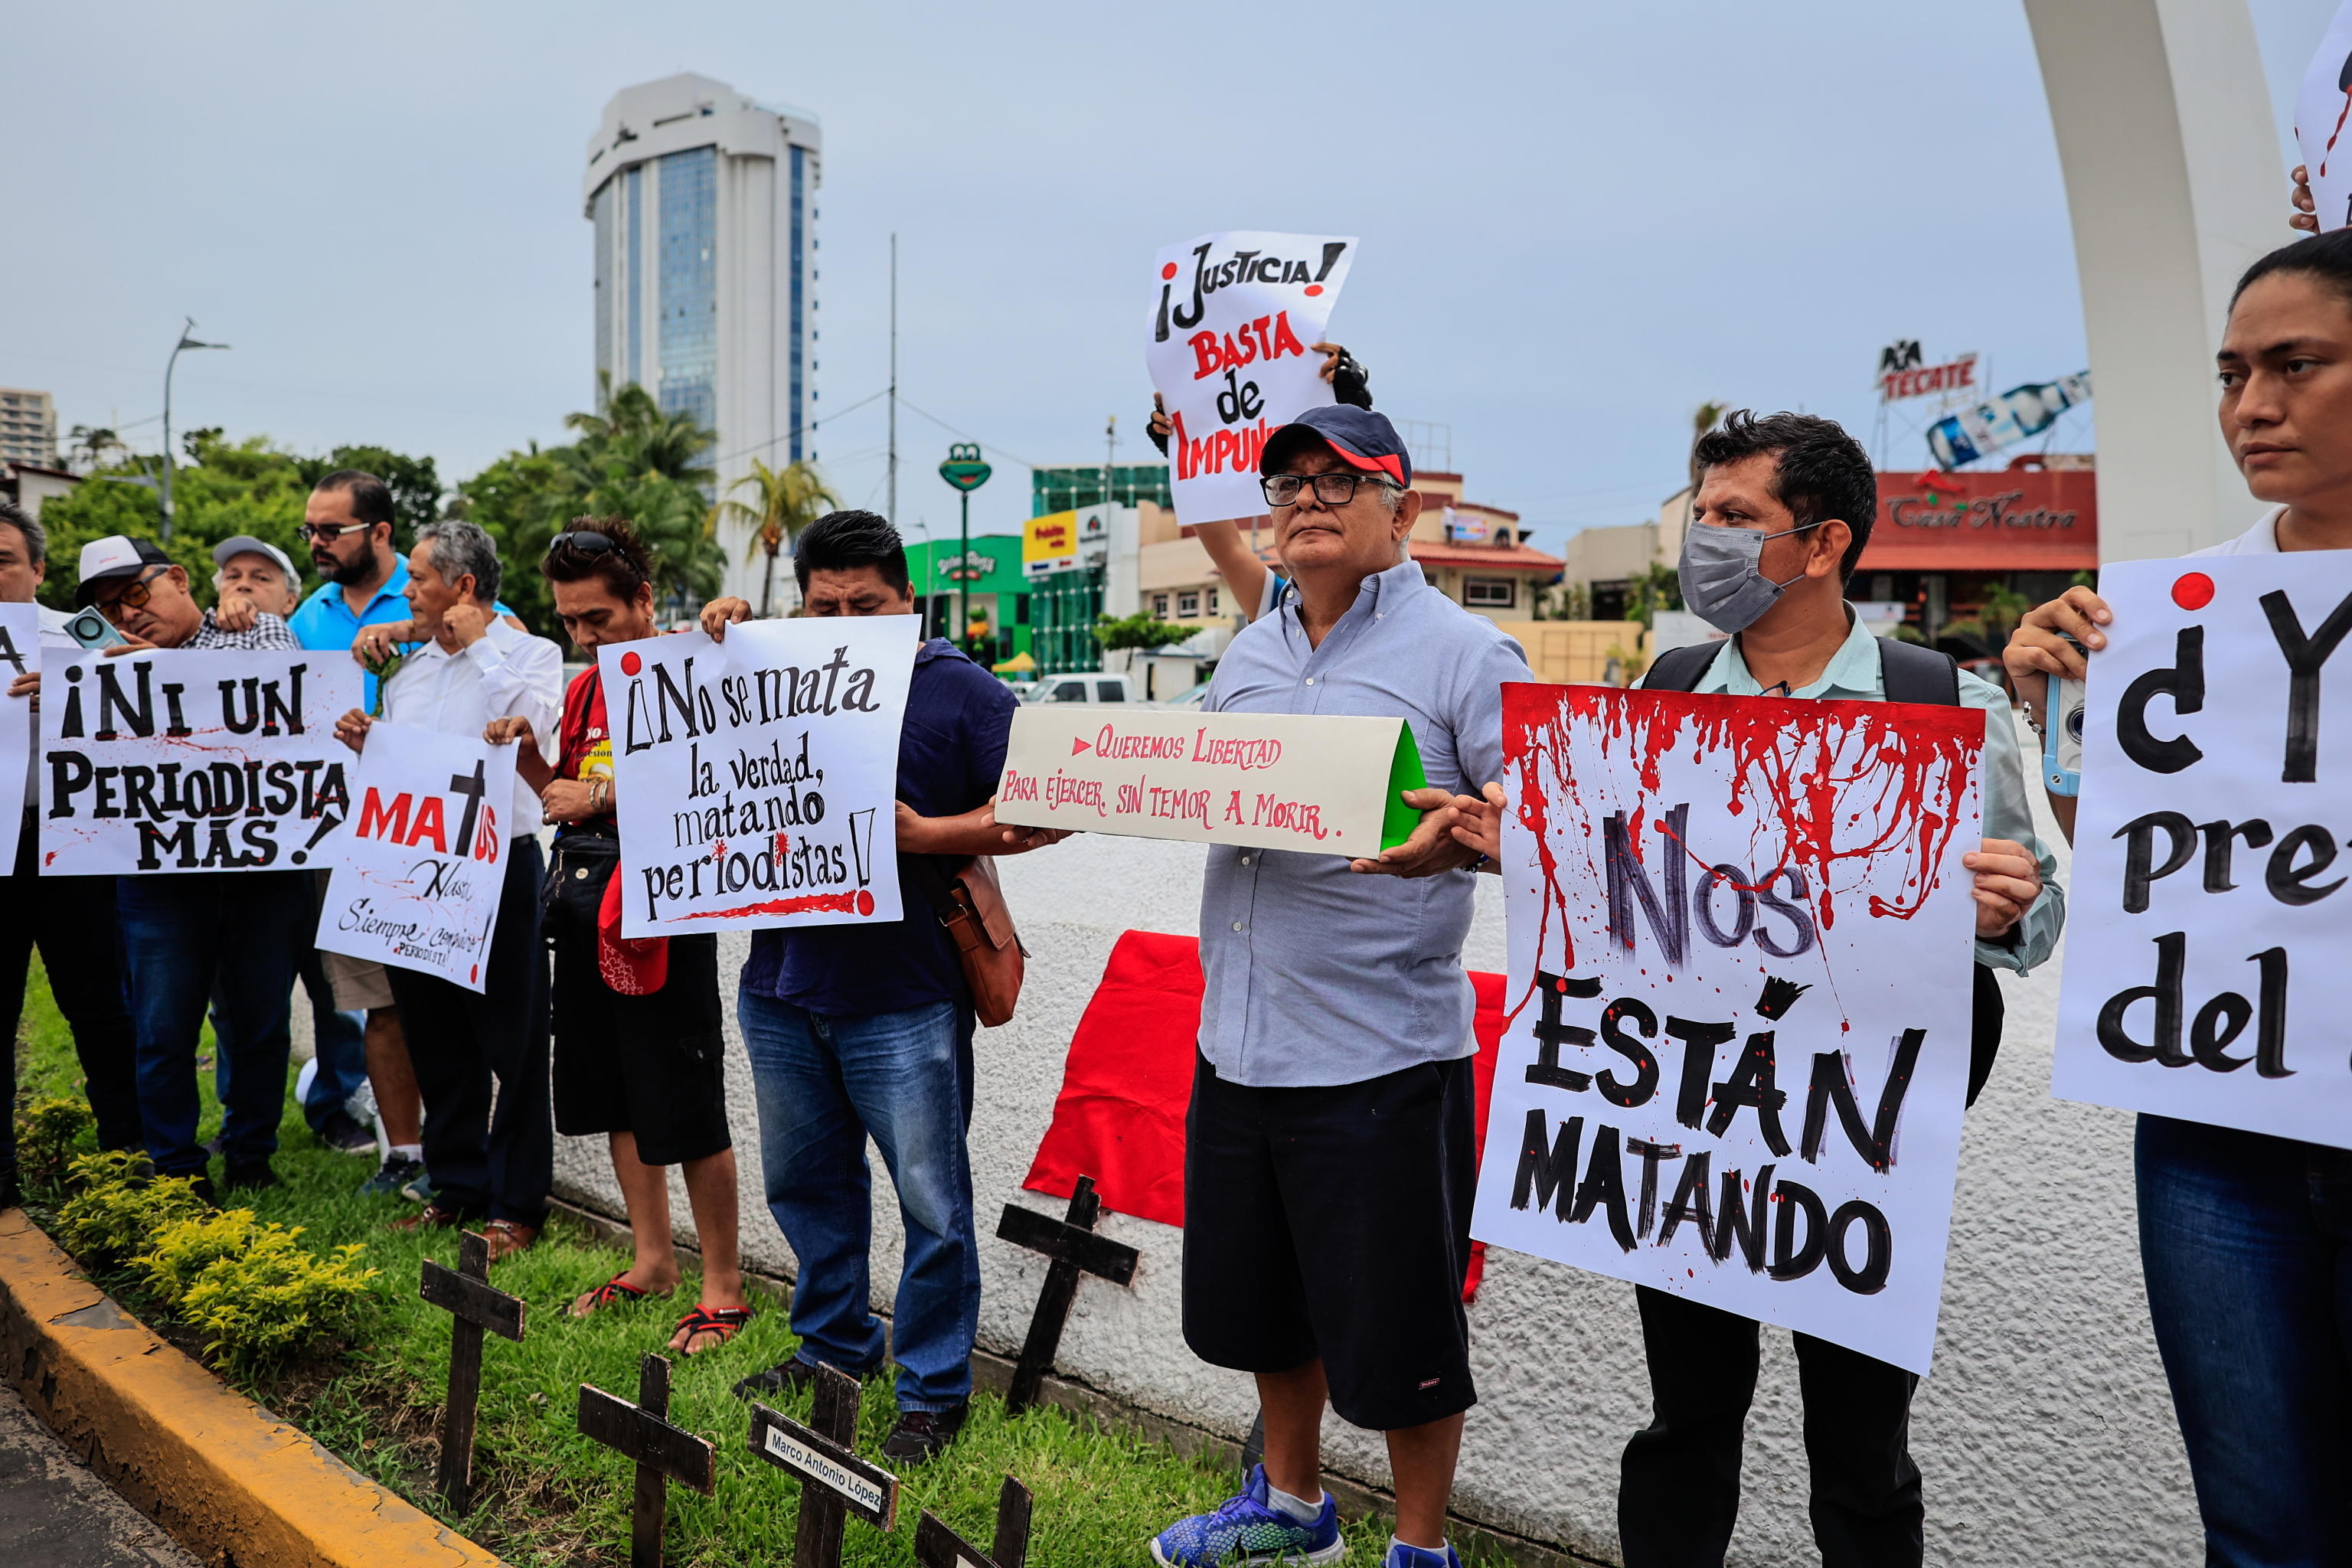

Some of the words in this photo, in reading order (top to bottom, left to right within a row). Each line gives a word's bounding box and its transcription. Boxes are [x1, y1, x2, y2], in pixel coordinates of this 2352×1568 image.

[1187, 311, 1305, 380] BASTA
[1883, 359, 1975, 399] TECATE
[1217, 368, 1264, 424] de
[1171, 410, 1286, 480] IMPUN
[1888, 498, 1961, 528] Casa
[61, 662, 192, 740] ¡NI
[218, 663, 307, 736] UN
[721, 674, 752, 728] se
[754, 645, 880, 726] mata
[688, 742, 720, 800] la
[729, 731, 824, 790] verdad,
[1096, 724, 1184, 760] QUEREMOS
[1191, 727, 1282, 770] LIBERTAD
[47, 750, 349, 823] PERIODISTA
[674, 786, 825, 848] matando
[1001, 769, 1038, 802] PARA
[1116, 774, 1145, 814] SIN
[1149, 787, 1214, 829] TEMOR
[1224, 790, 1245, 826] A
[642, 808, 876, 922] periodistas!
[2111, 811, 2352, 913] pre
[2097, 931, 2298, 1079] del
[1525, 972, 1927, 1175] ESTÁN
[1510, 1109, 1892, 1295] MATANDO
[773, 1433, 802, 1462] Marco
[804, 1452, 845, 1486] Antonio
[848, 1475, 880, 1506] López
